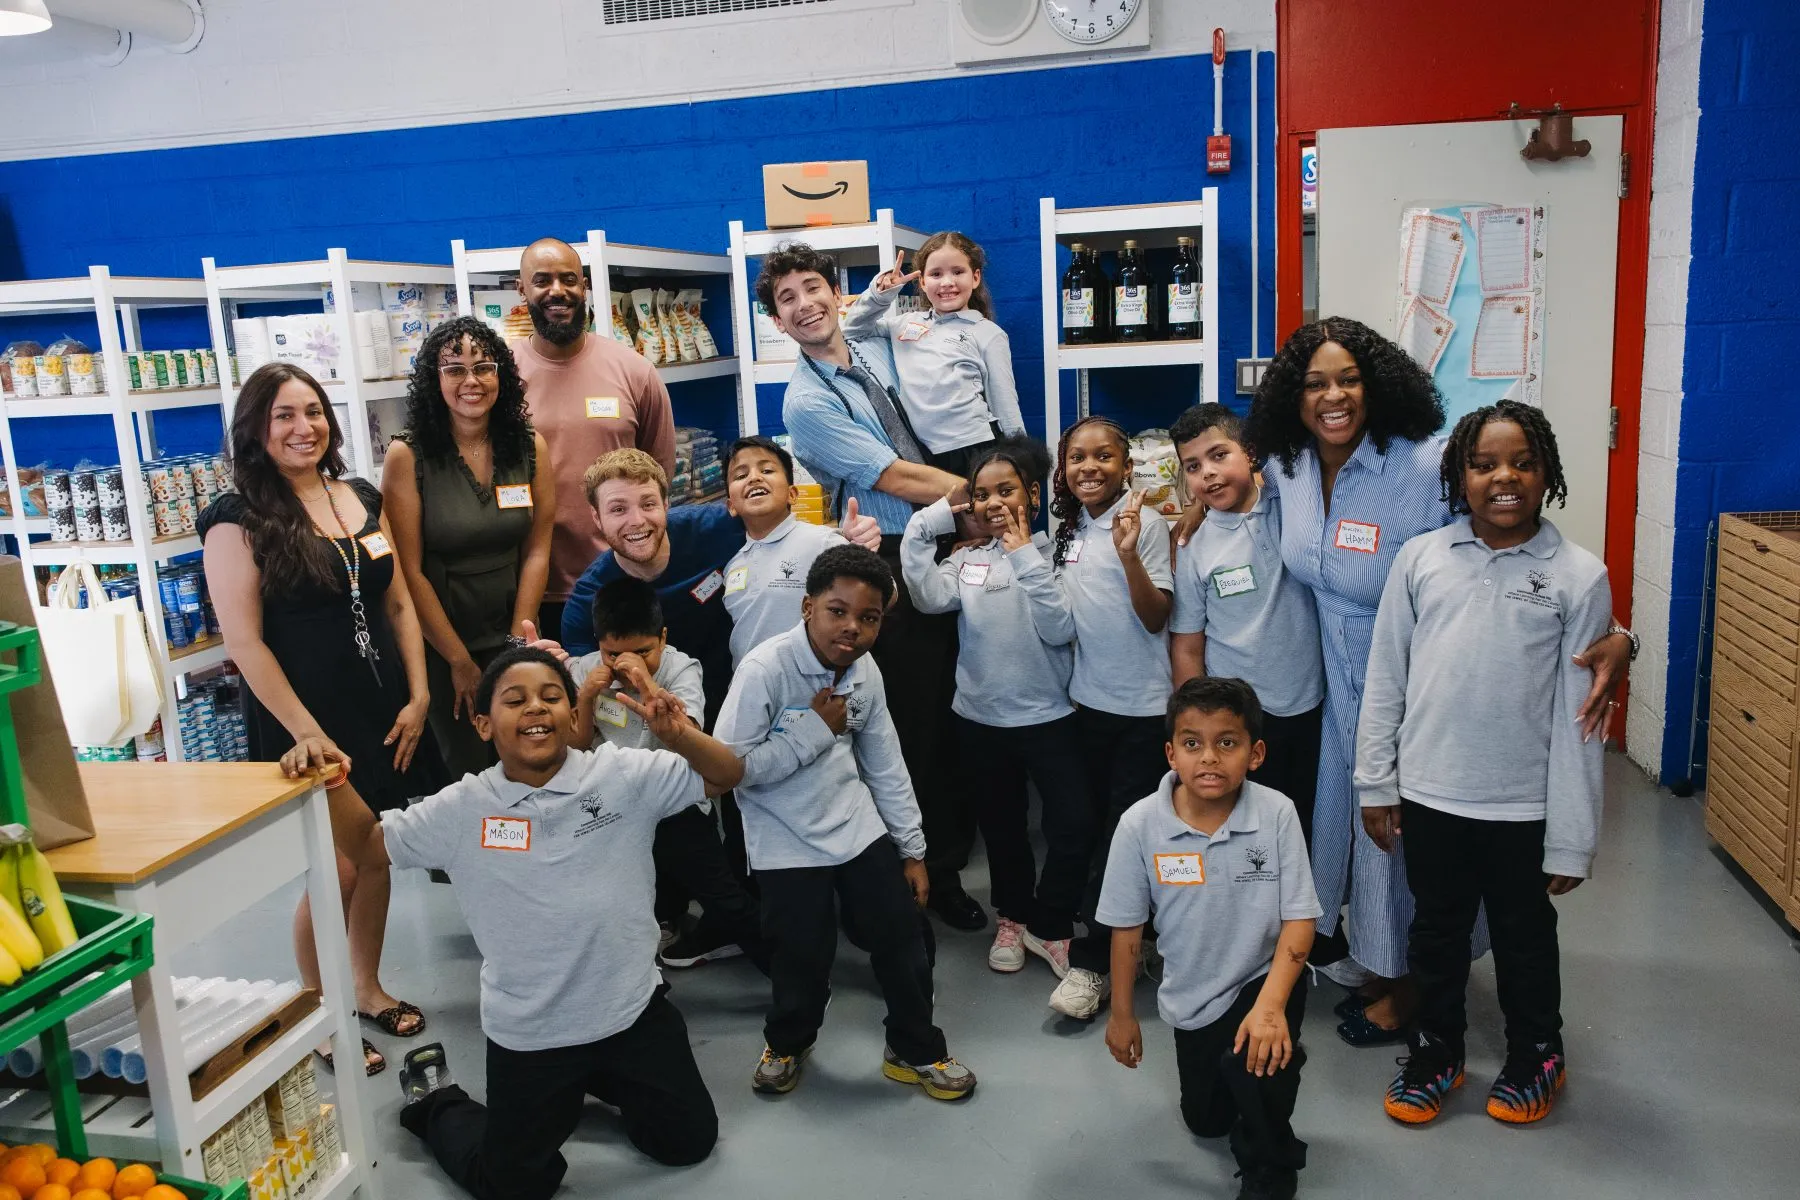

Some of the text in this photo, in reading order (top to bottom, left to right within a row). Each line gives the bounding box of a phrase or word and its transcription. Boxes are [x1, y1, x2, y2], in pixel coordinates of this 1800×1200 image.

[1120, 0, 1126, 12] 4
[1071, 18, 1078, 30] 7
[1106, 15, 1113, 26] 5
[1088, 22, 1095, 34] 6
[599, 702, 619, 716] ANGEL
[489, 828, 524, 840] MASON
[1161, 864, 1197, 878] SAMUEL
